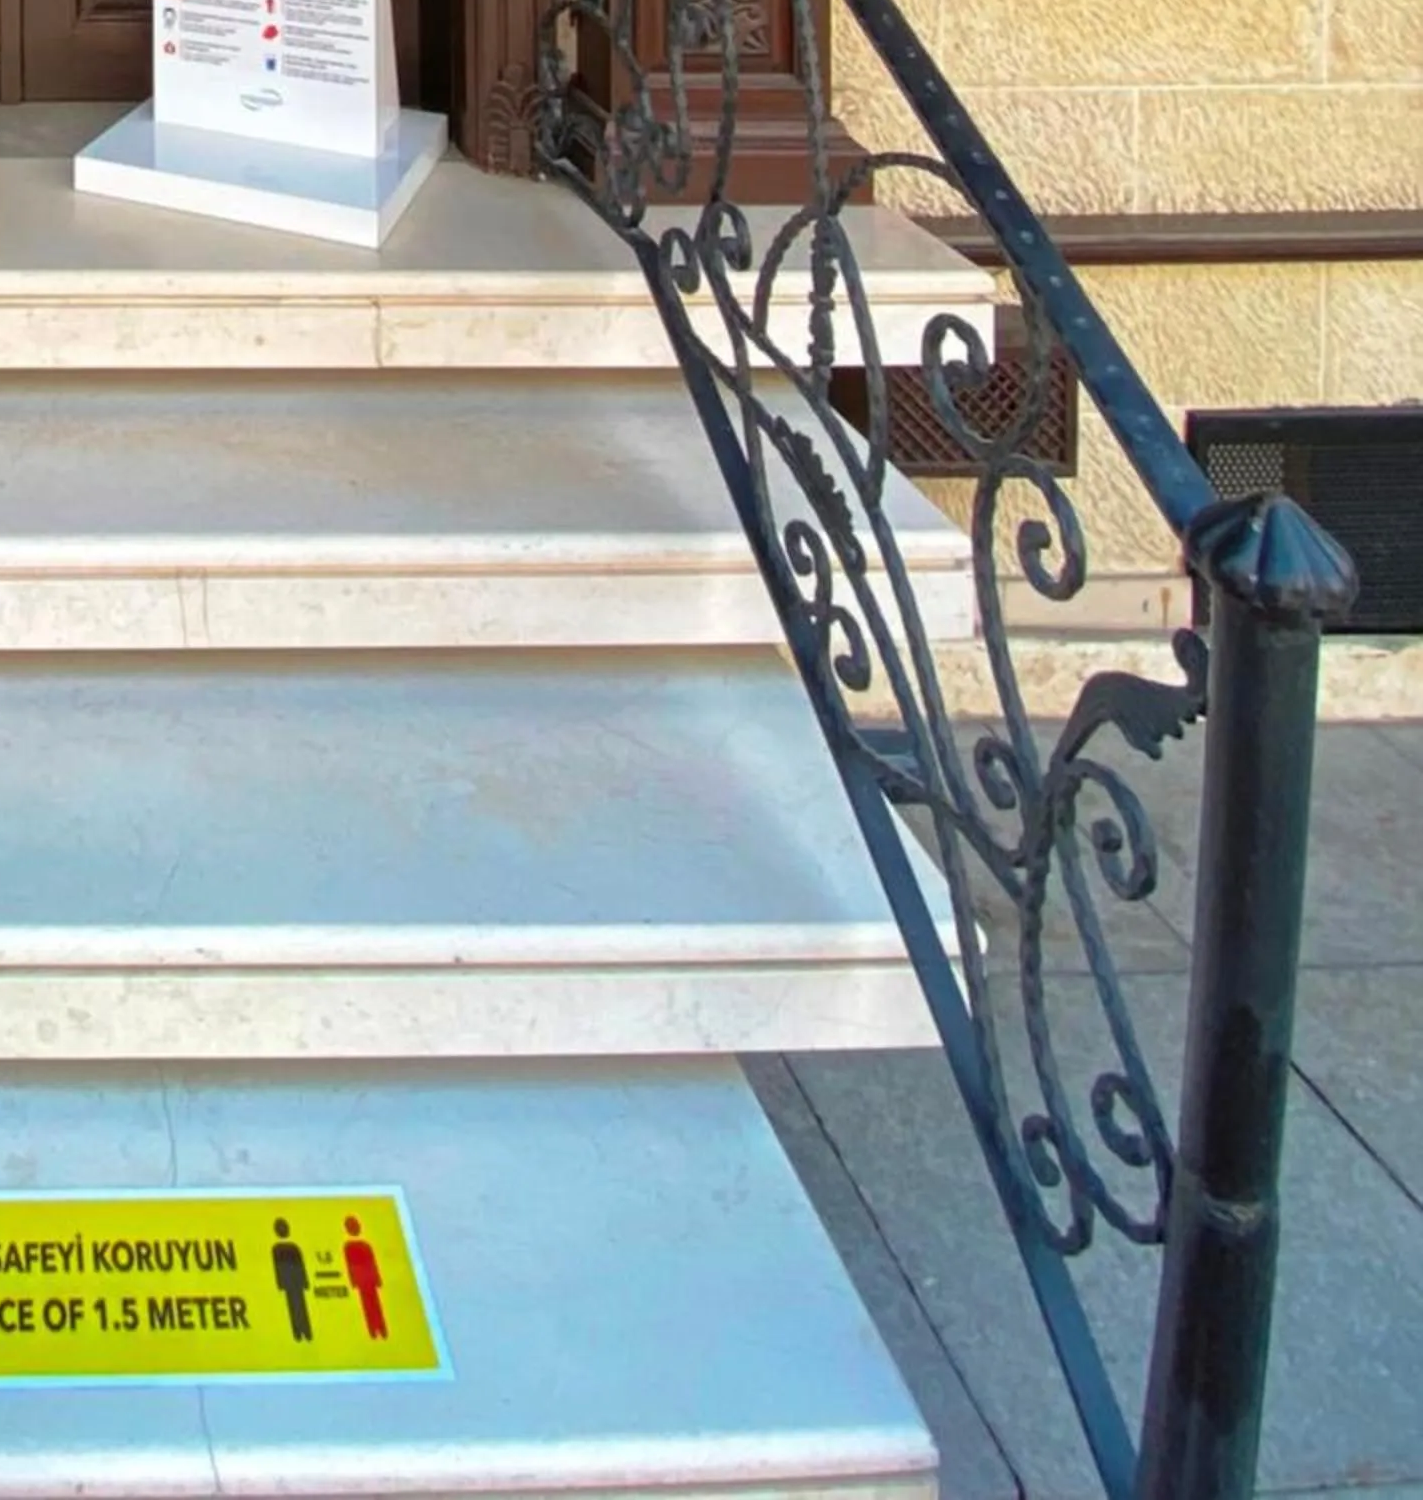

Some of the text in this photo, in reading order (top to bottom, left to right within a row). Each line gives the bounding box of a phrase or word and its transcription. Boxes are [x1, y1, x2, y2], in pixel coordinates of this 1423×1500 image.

[92, 1239, 238, 1273] KORUYUN
[42, 1298, 85, 1333] OF
[92, 1297, 140, 1332] 1.5
[147, 1296, 251, 1331] METER
